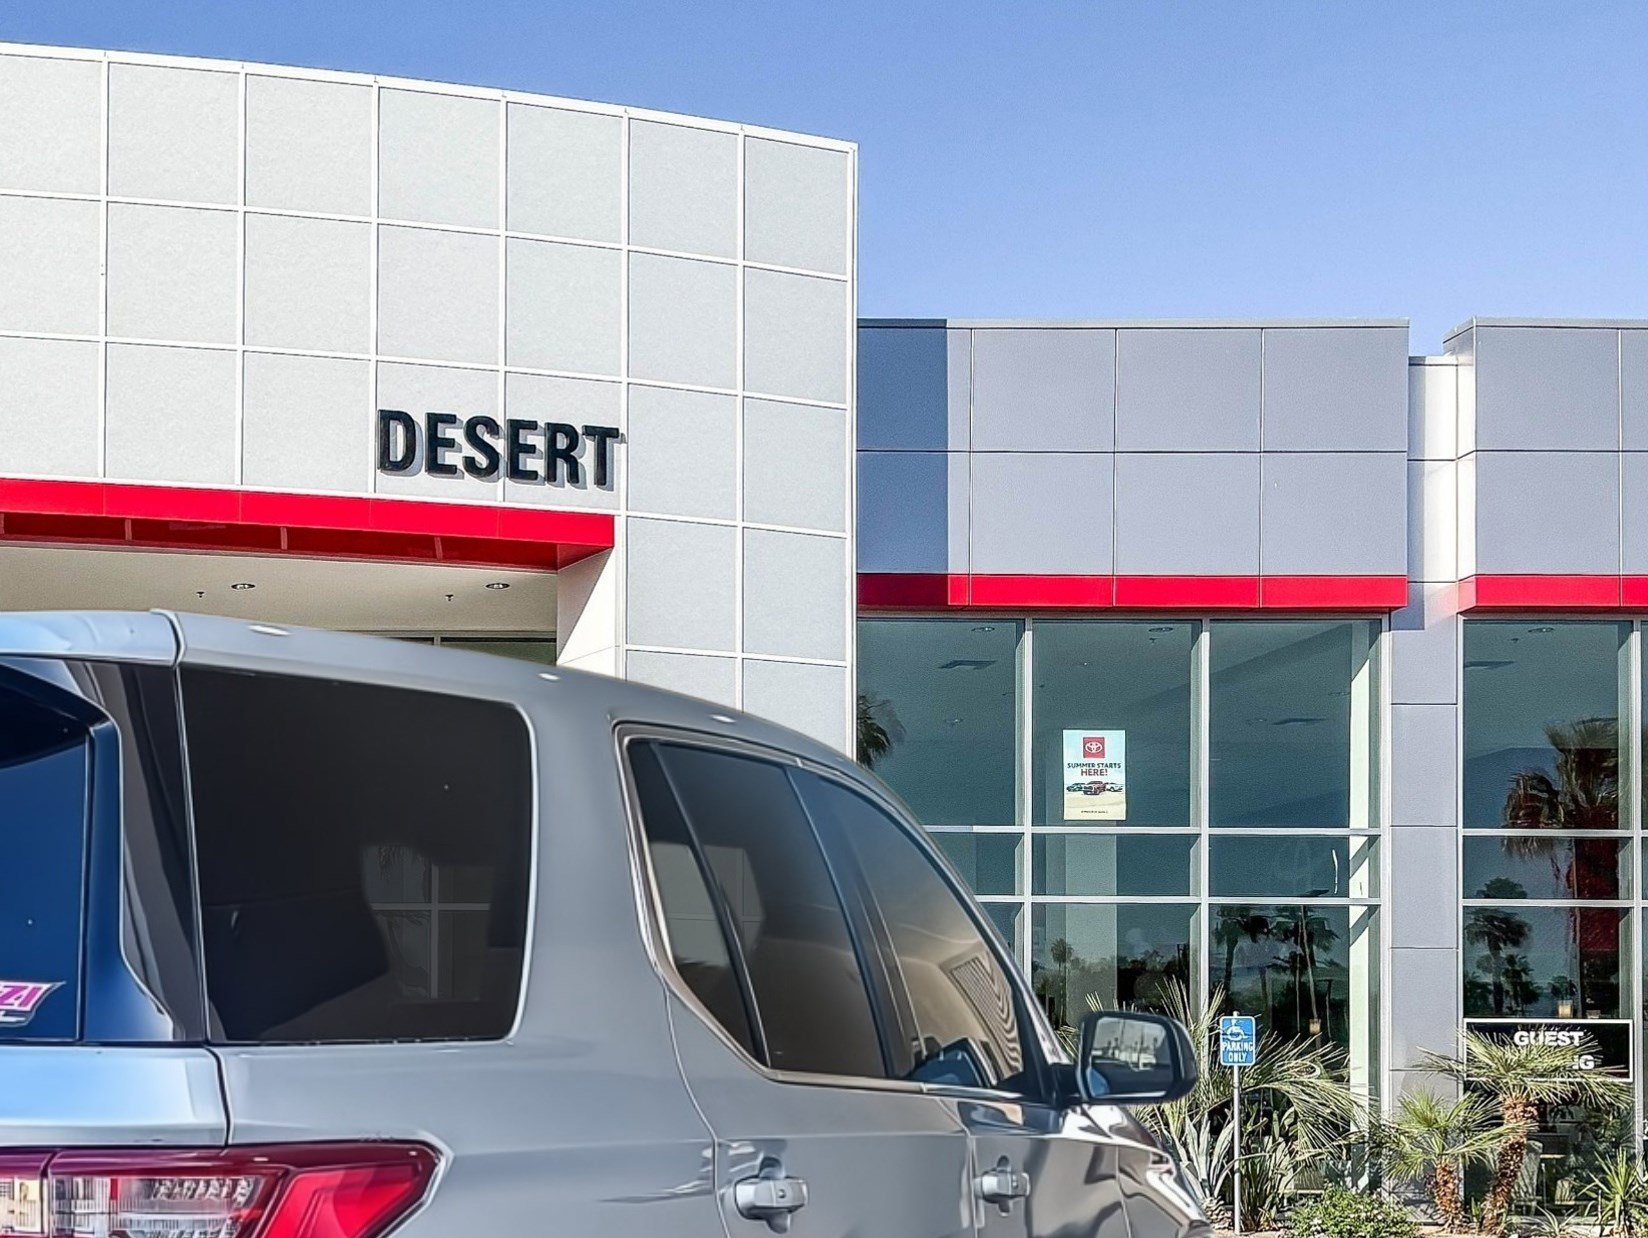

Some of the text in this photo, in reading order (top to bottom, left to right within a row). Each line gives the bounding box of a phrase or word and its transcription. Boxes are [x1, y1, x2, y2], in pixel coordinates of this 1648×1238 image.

[376, 409, 620, 487] DESERT
[1080, 768, 1108, 776] HERE!
[1513, 1030, 1584, 1047] GUEST
[1222, 1041, 1253, 1051] PARKING
[1228, 1051, 1248, 1062] ONLY
